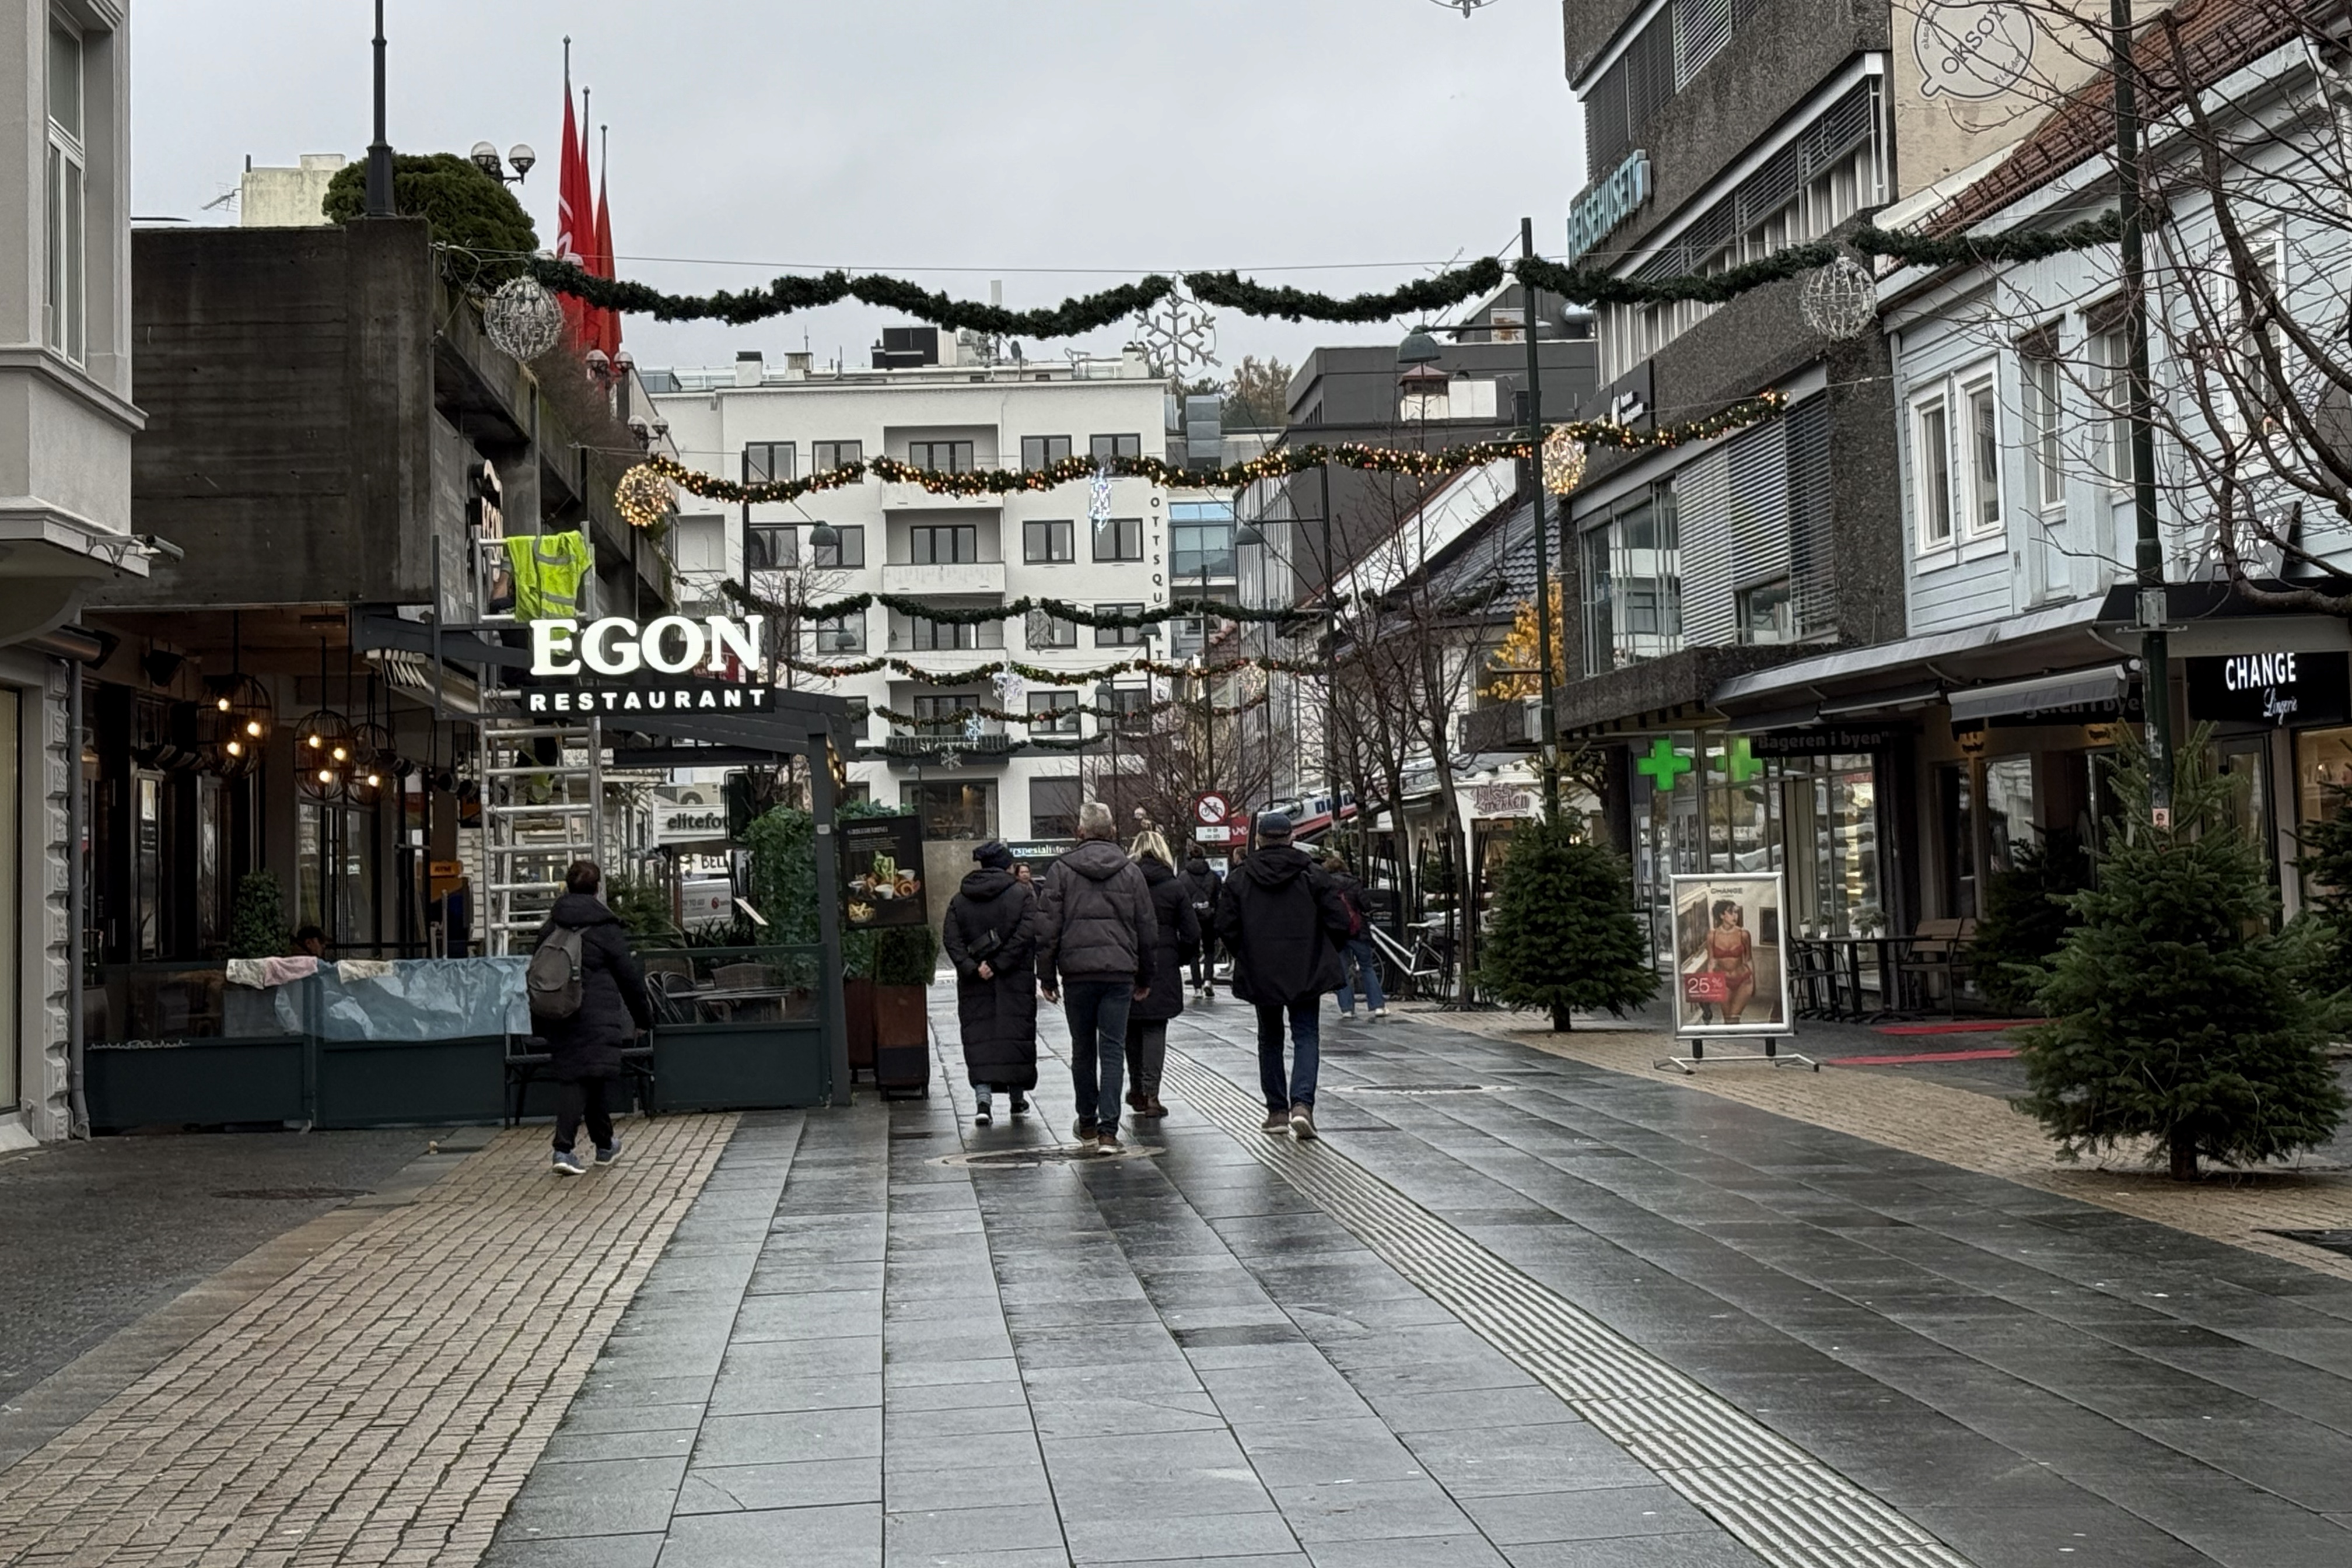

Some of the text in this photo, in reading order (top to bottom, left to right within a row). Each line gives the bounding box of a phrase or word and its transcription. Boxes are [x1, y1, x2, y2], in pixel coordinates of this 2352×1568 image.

[1942, 4, 2007, 74] OKSØY
[530, 615, 764, 676] EGON
[2225, 653, 2297, 691] CHANGE
[530, 690, 765, 711] RESTAURANT
[1831, 732, 1836, 746] i
